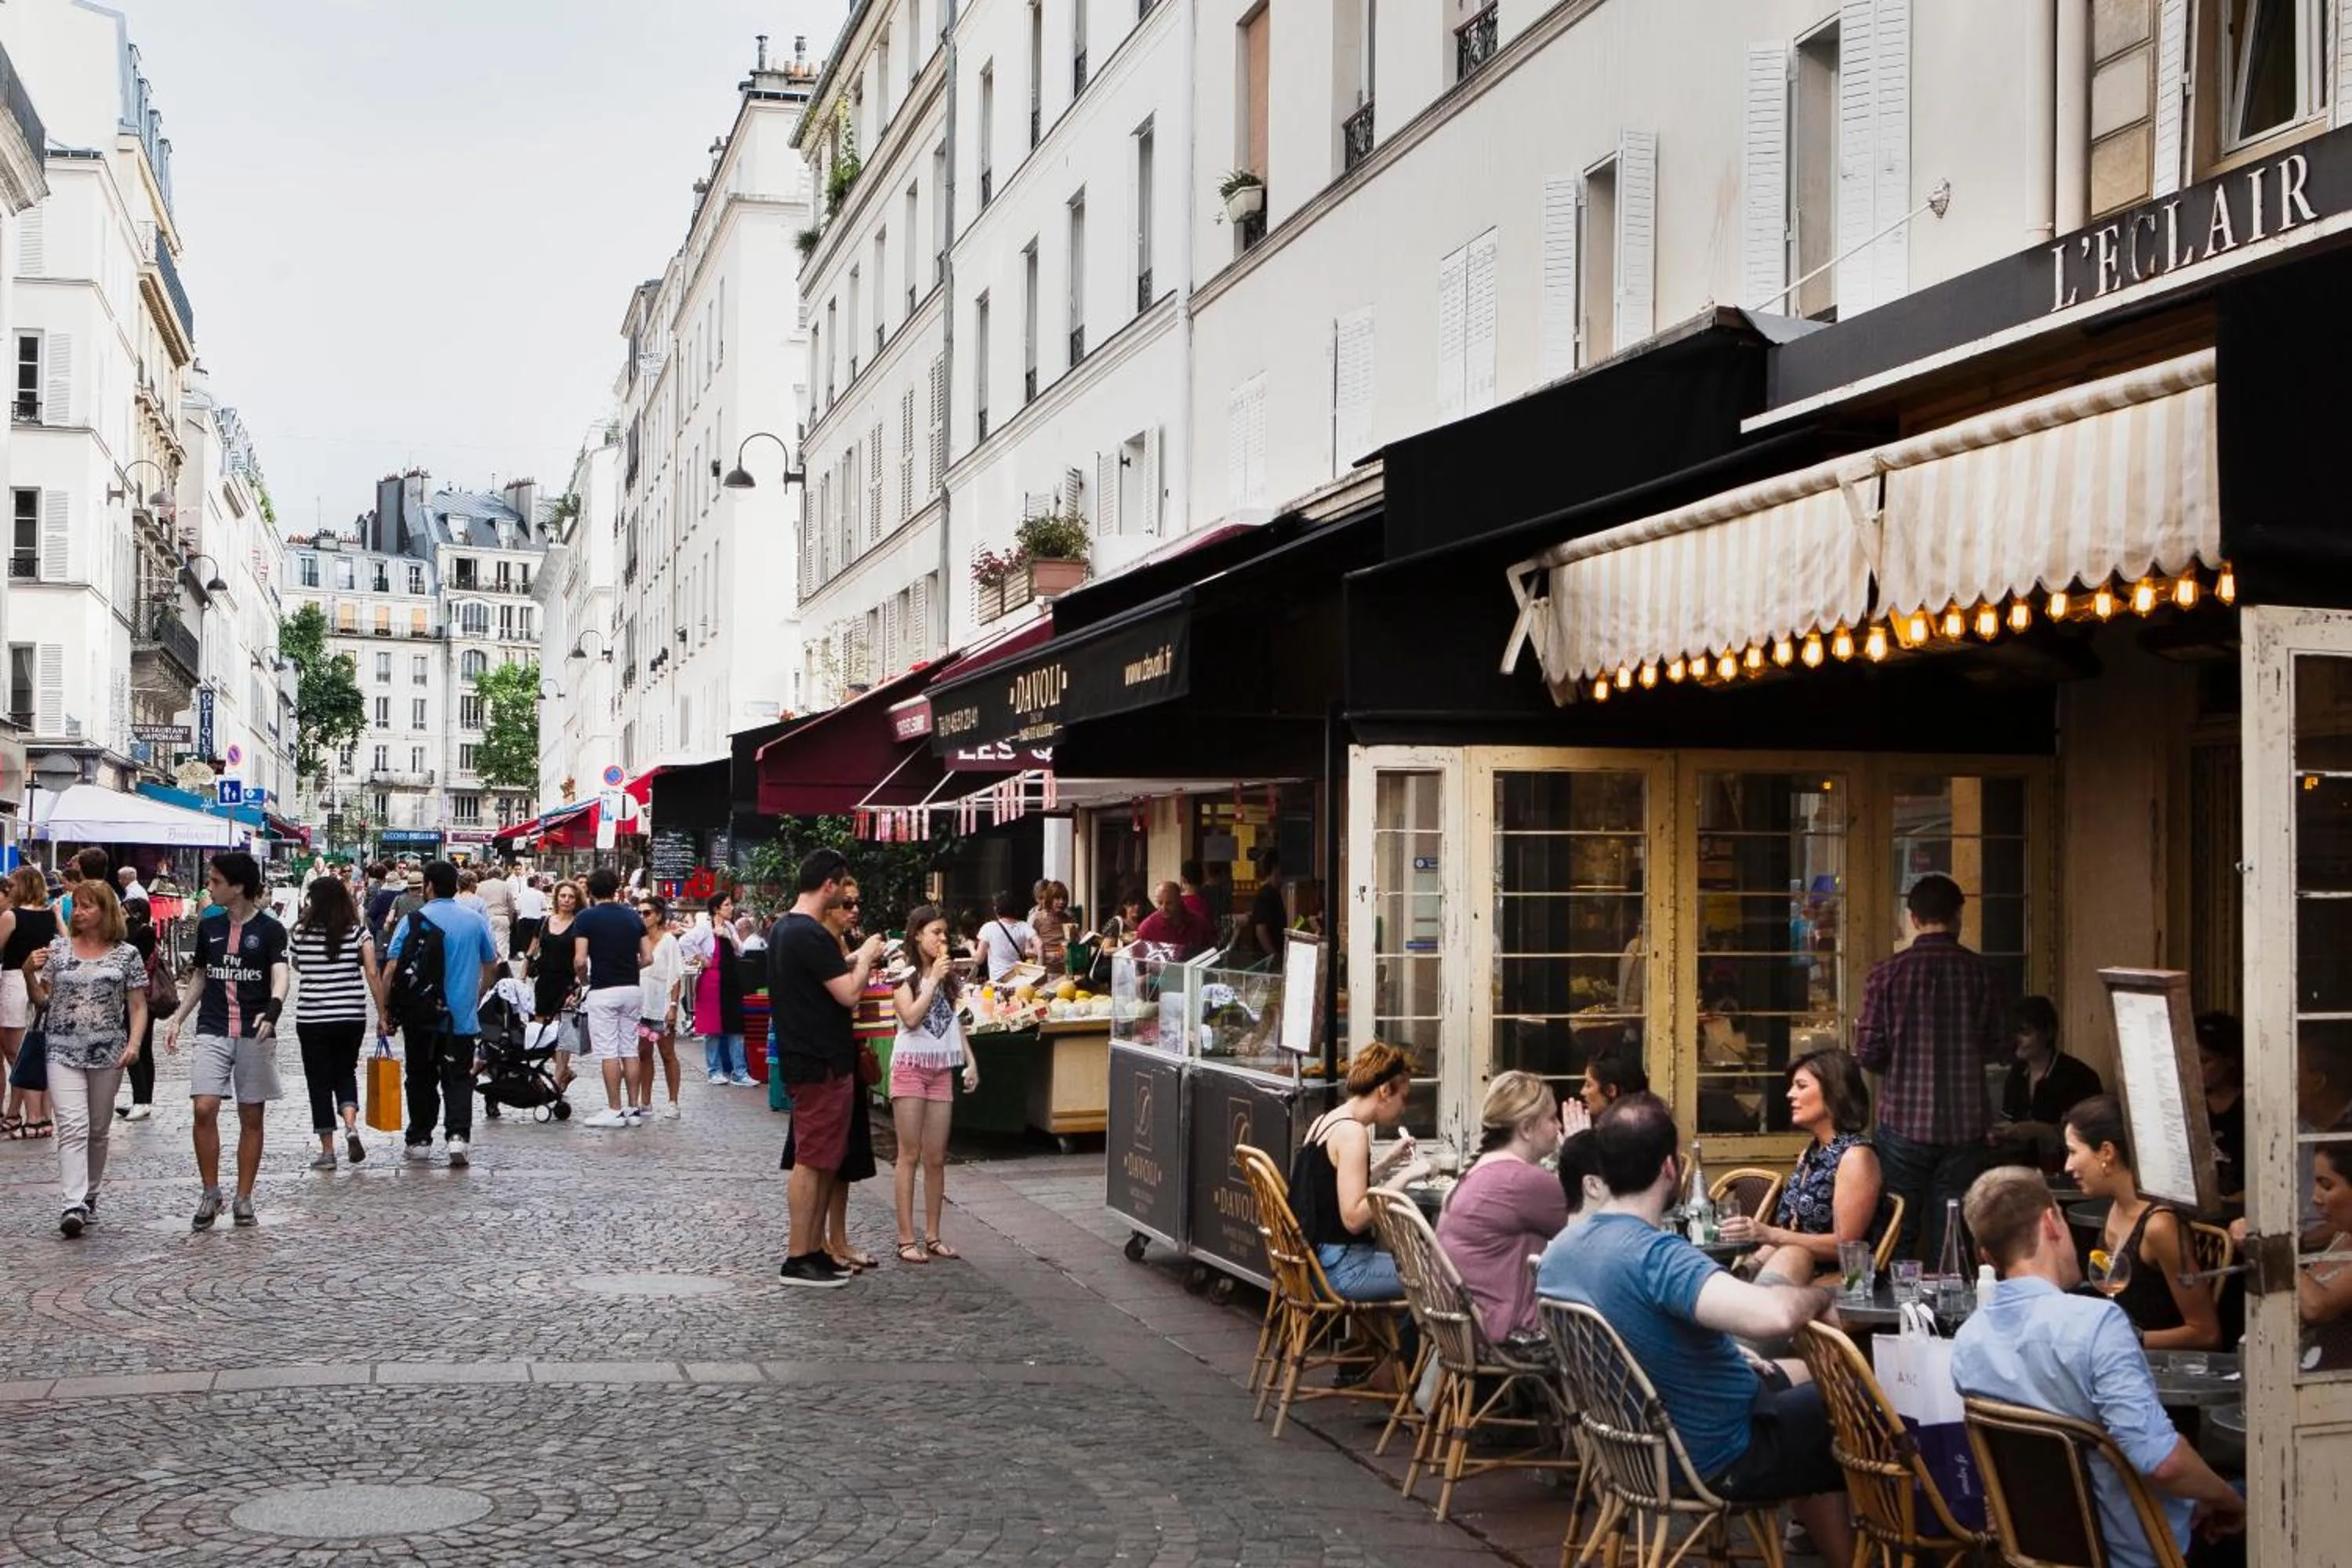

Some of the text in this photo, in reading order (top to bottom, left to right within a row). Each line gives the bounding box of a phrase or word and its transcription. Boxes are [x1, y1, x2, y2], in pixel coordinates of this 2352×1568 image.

[2050, 154, 2318, 313] L'ECLAIR
[1015, 664, 1062, 714] DAVOLI
[206, 964, 263, 981] Emirates
[223, 954, 241, 967] Fly
